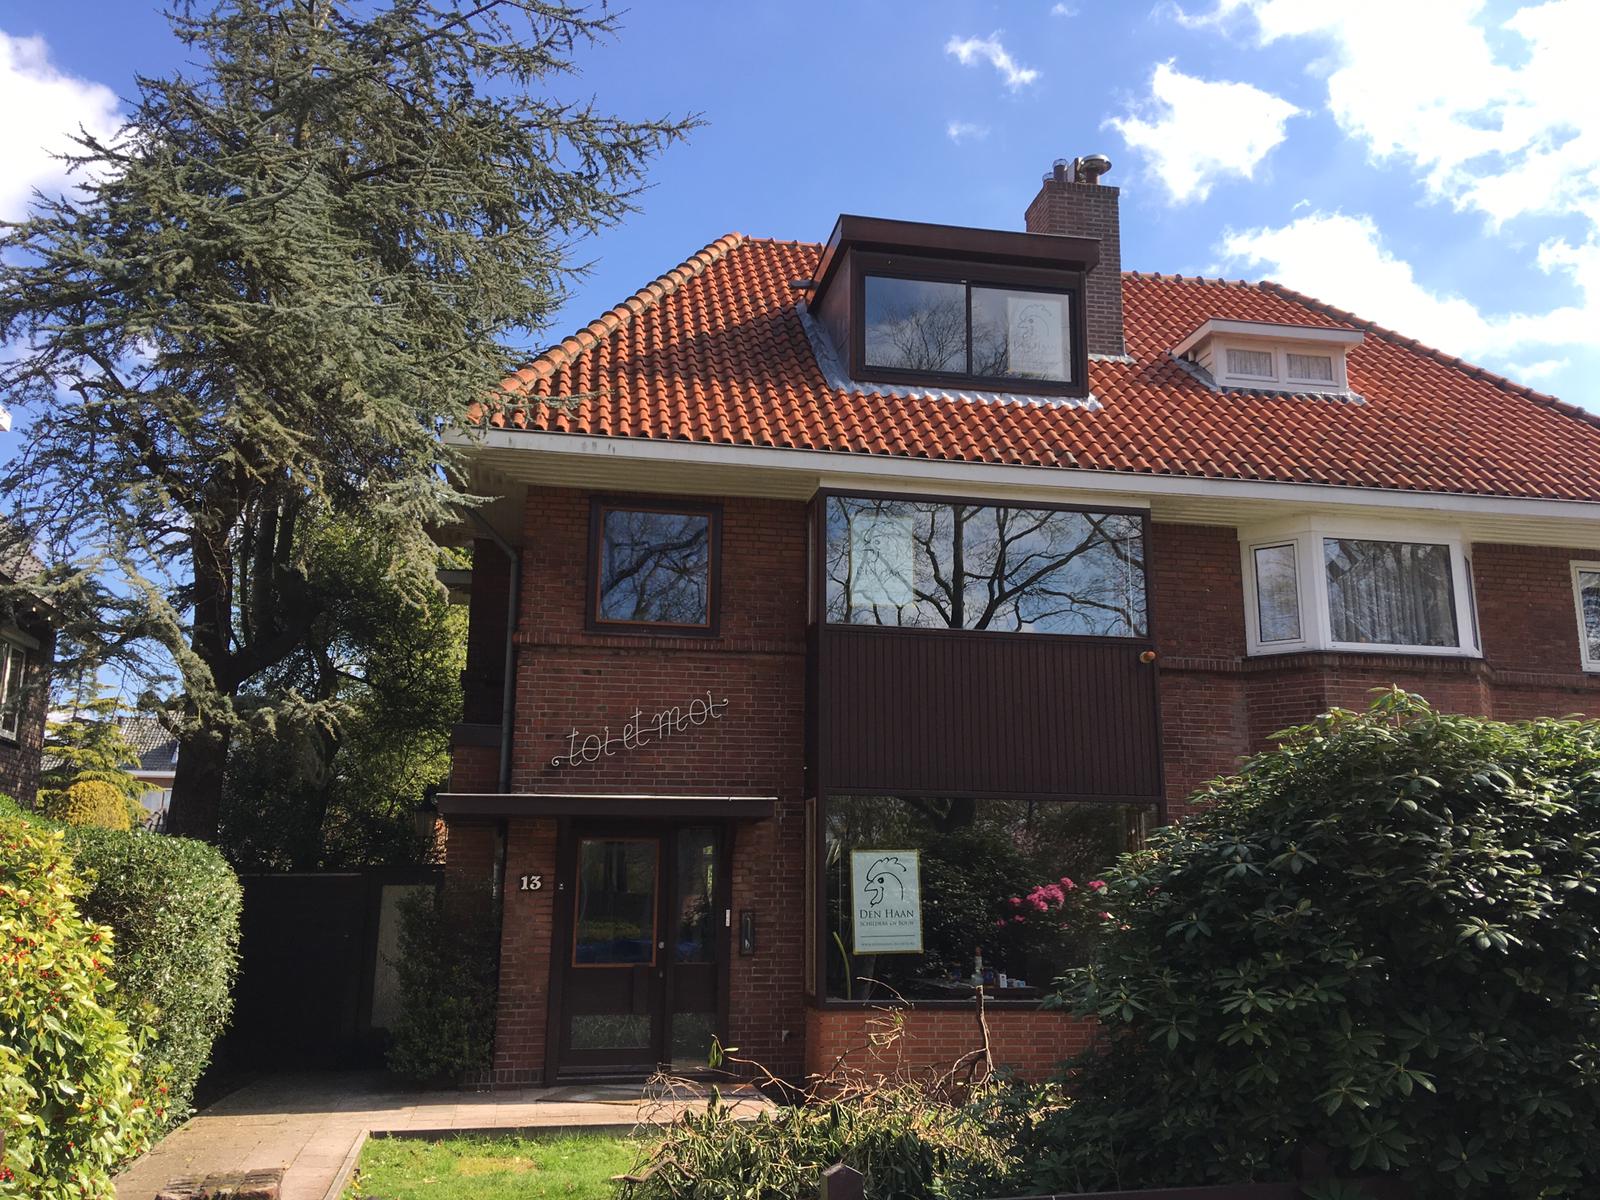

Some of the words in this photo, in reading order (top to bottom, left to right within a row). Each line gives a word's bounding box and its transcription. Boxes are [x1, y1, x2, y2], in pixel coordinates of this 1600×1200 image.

[552, 726, 617, 766] toi
[624, 707, 650, 749] et
[651, 690, 728, 739] moi
[520, 875, 542, 890] 13
[860, 910, 881, 919] DEN
[886, 909, 914, 918] HAAN
